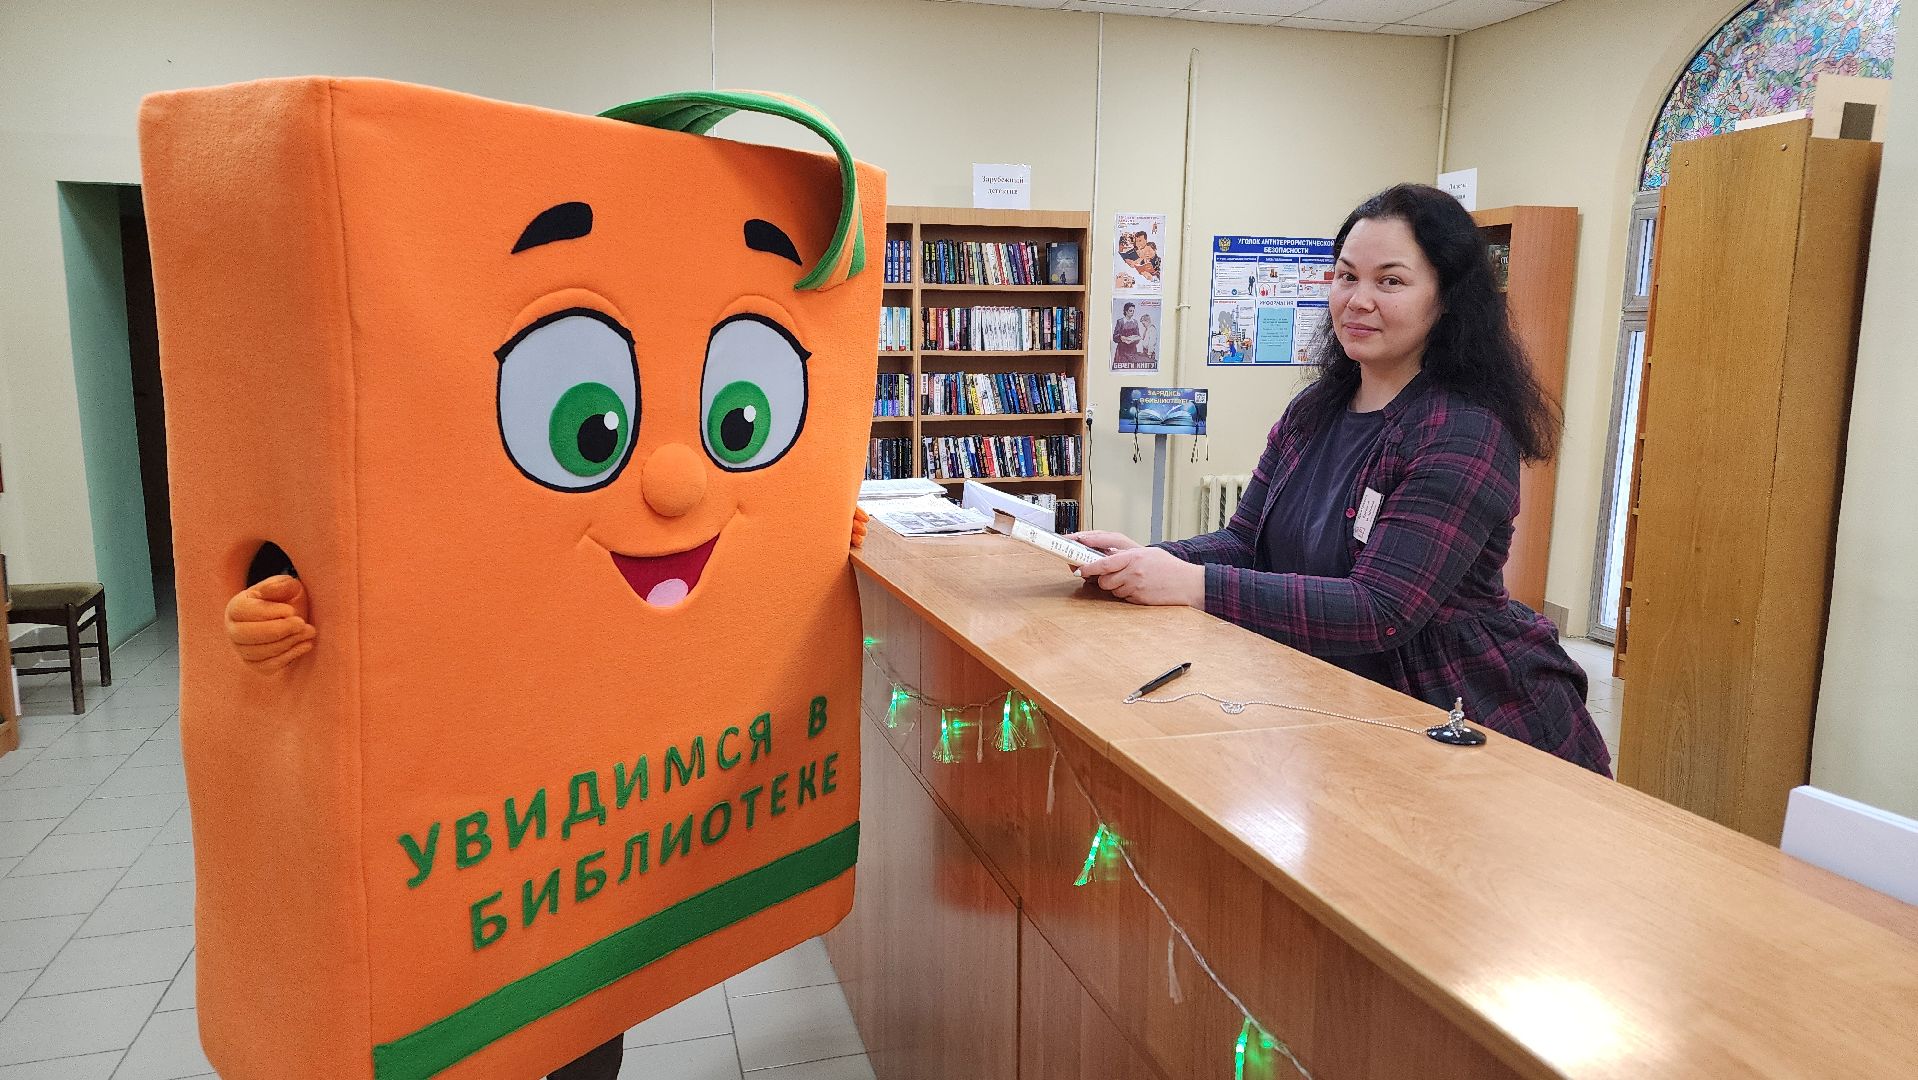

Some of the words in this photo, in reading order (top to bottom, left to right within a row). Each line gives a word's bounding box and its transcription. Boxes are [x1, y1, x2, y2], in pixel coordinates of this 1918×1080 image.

[1261, 238, 1335, 247] АНТИТЕРРОРИСТИЧЕСКОЙ
[1263, 246, 1309, 254] БЕЗОПАСНОСТИ
[397, 711, 772, 889] УВИДИМСЯ
[807, 695, 828, 739] В
[470, 752, 840, 952] БИБЛИОТЕКЕ
